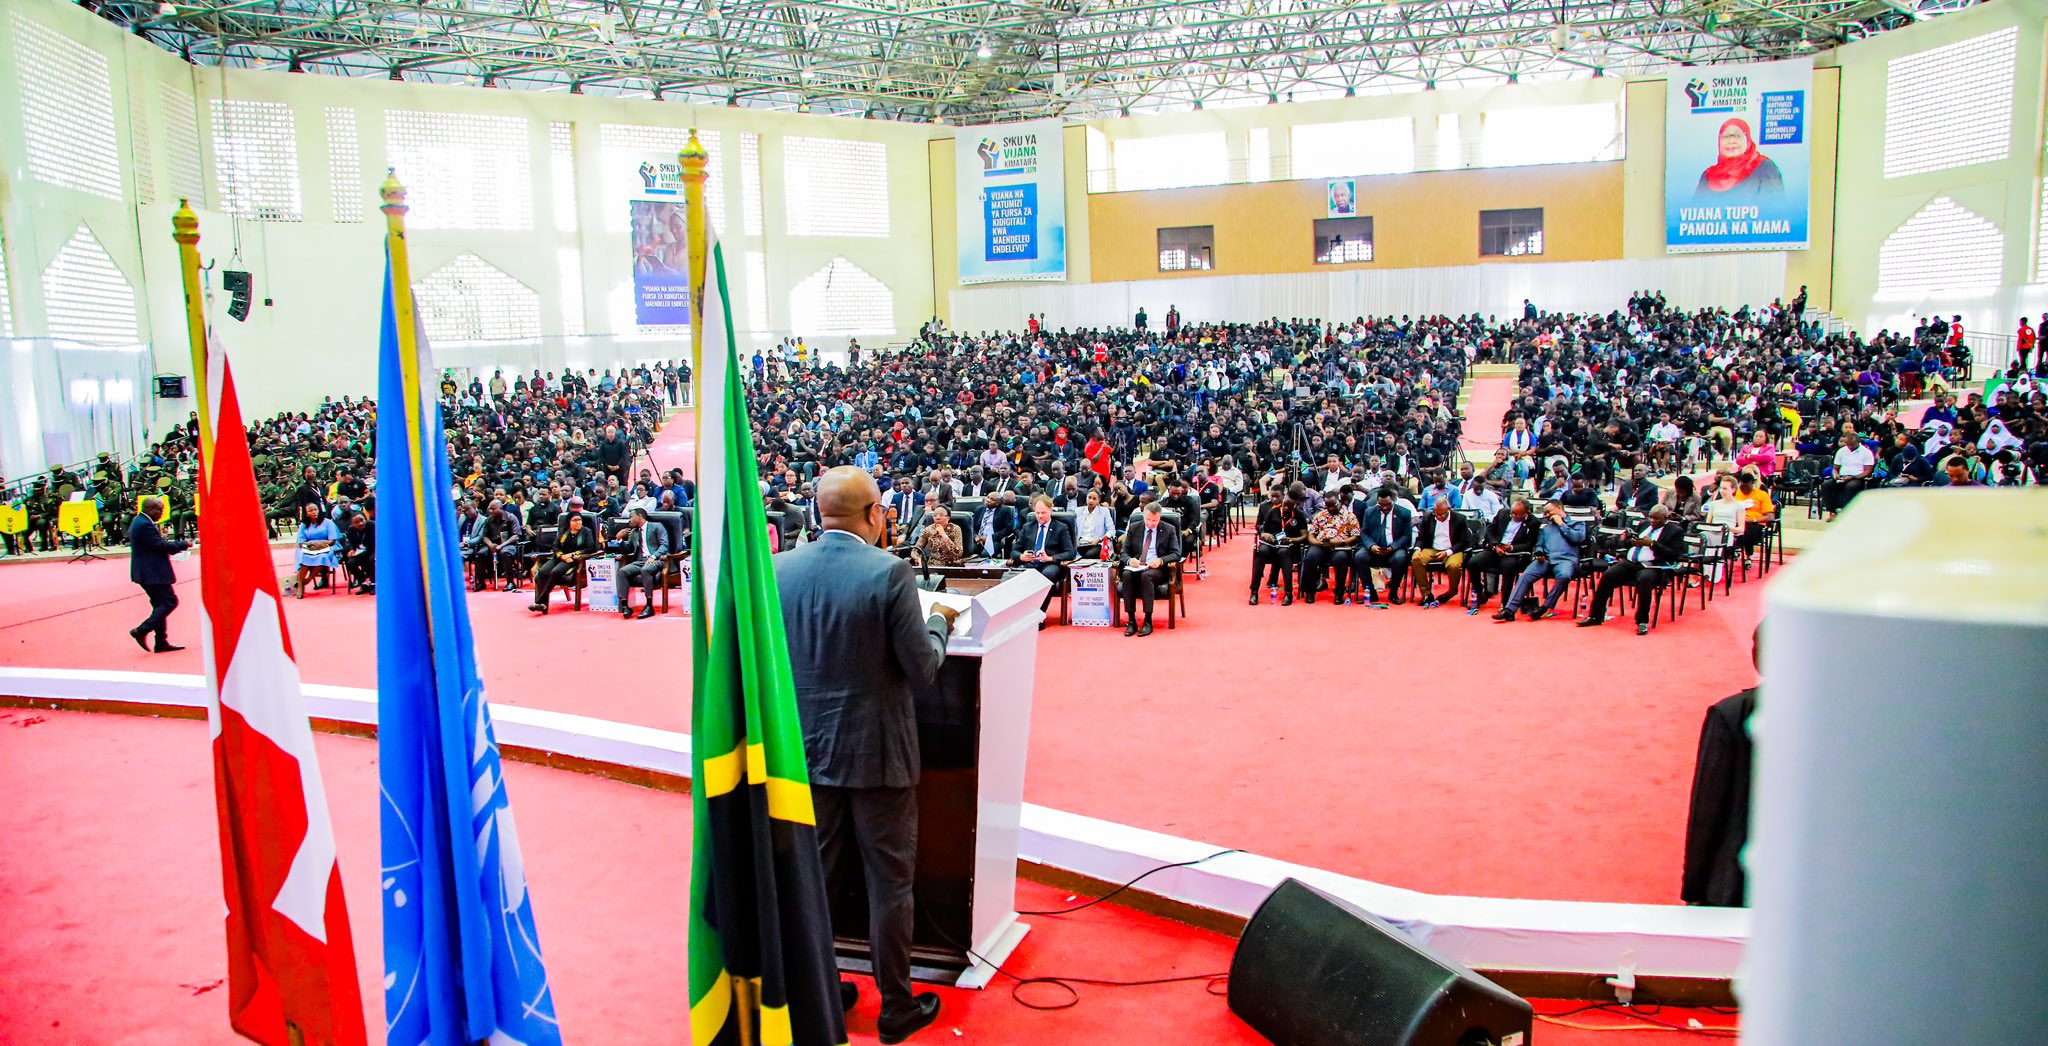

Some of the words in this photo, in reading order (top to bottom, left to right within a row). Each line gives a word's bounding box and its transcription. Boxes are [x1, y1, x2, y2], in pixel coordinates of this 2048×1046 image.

[1735, 76, 1747, 86] YA
[1712, 87, 1747, 98] VIJANA
[1712, 98, 1747, 106] KIMATAIFA
[1025, 134, 1036, 145] YA
[1004, 146, 1037, 158] VIJANA
[1004, 158, 1037, 168] KIMATAIFA
[991, 191, 1013, 200] VIJANA
[1014, 190, 1024, 198] NA
[992, 199, 1022, 209] MATUMIZI
[992, 210, 1000, 218] YA
[1001, 208, 1022, 218] FURSA
[1024, 207, 1032, 216] ZA
[1680, 208, 1722, 222] VIJANA
[1726, 206, 1759, 220] TUPO
[992, 217, 1026, 227] KIDIGITALI
[992, 227, 1007, 236] KWA
[1680, 222, 1728, 236] PAMOJA
[1731, 221, 1748, 235] NA
[1752, 220, 1790, 234] MAMA
[992, 235, 1030, 245] MAENDELEO
